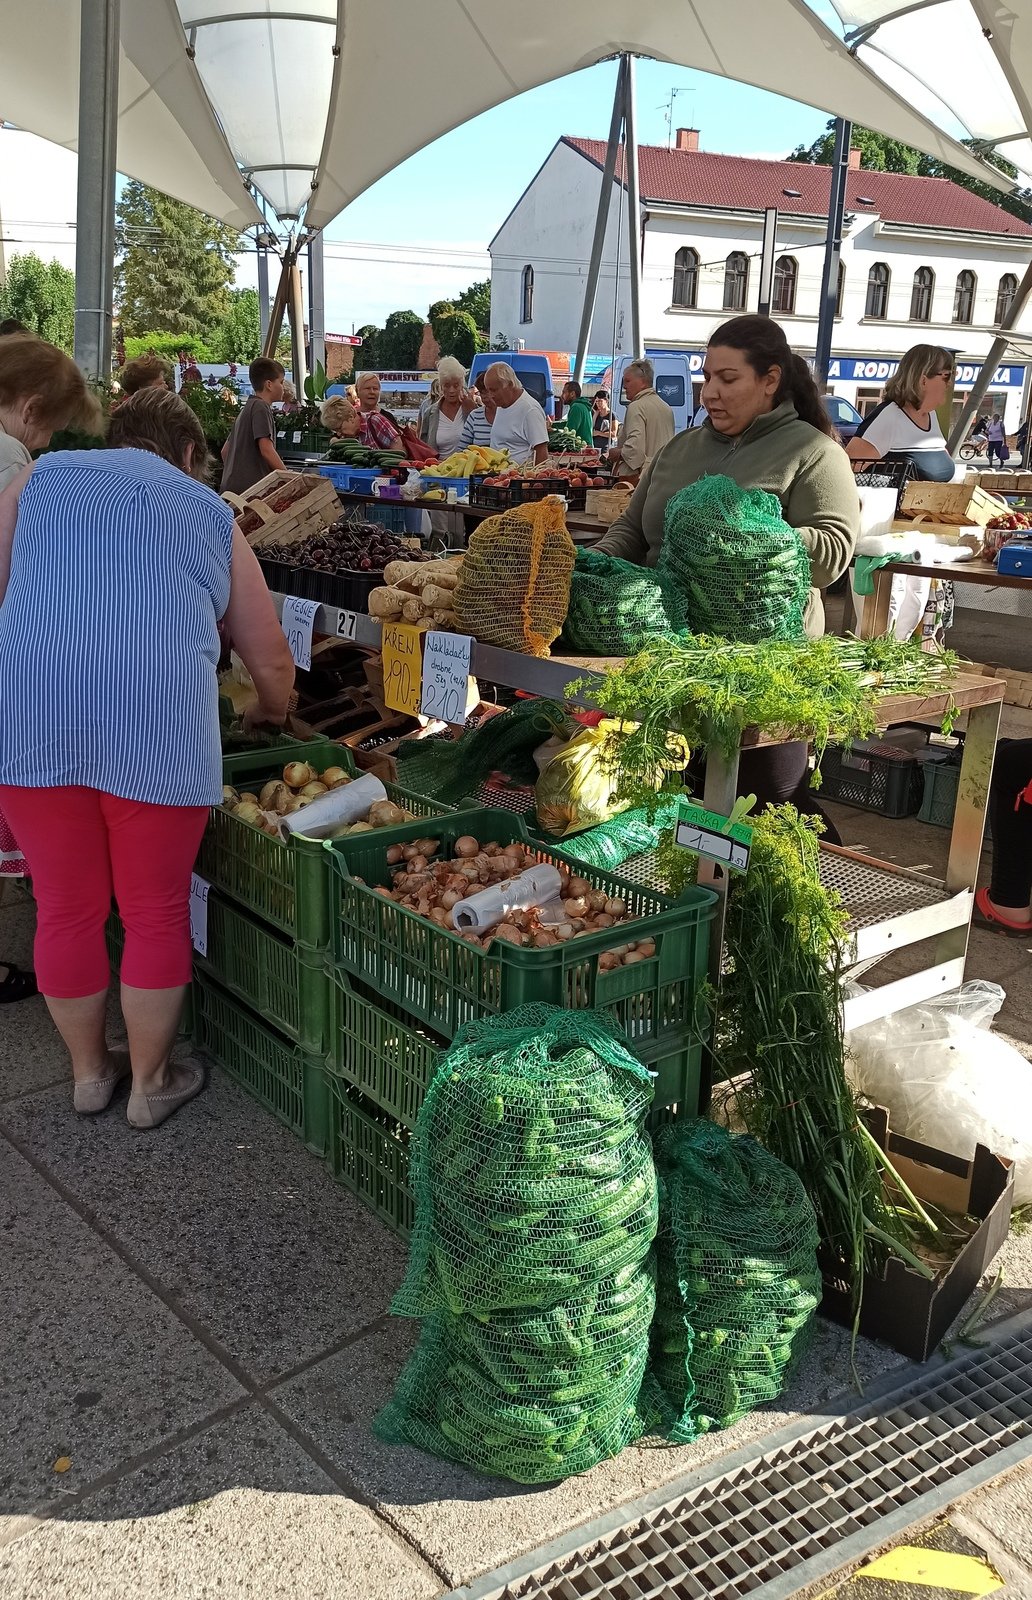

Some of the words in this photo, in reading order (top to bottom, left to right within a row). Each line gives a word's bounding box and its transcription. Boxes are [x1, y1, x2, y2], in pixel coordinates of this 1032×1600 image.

[338, 612, 356, 637] 27
[384, 627, 415, 655] KŘEN
[431, 658, 453, 674] drobné
[423, 684, 462, 722] 210,-
[682, 808, 720, 830] TAŠKA
